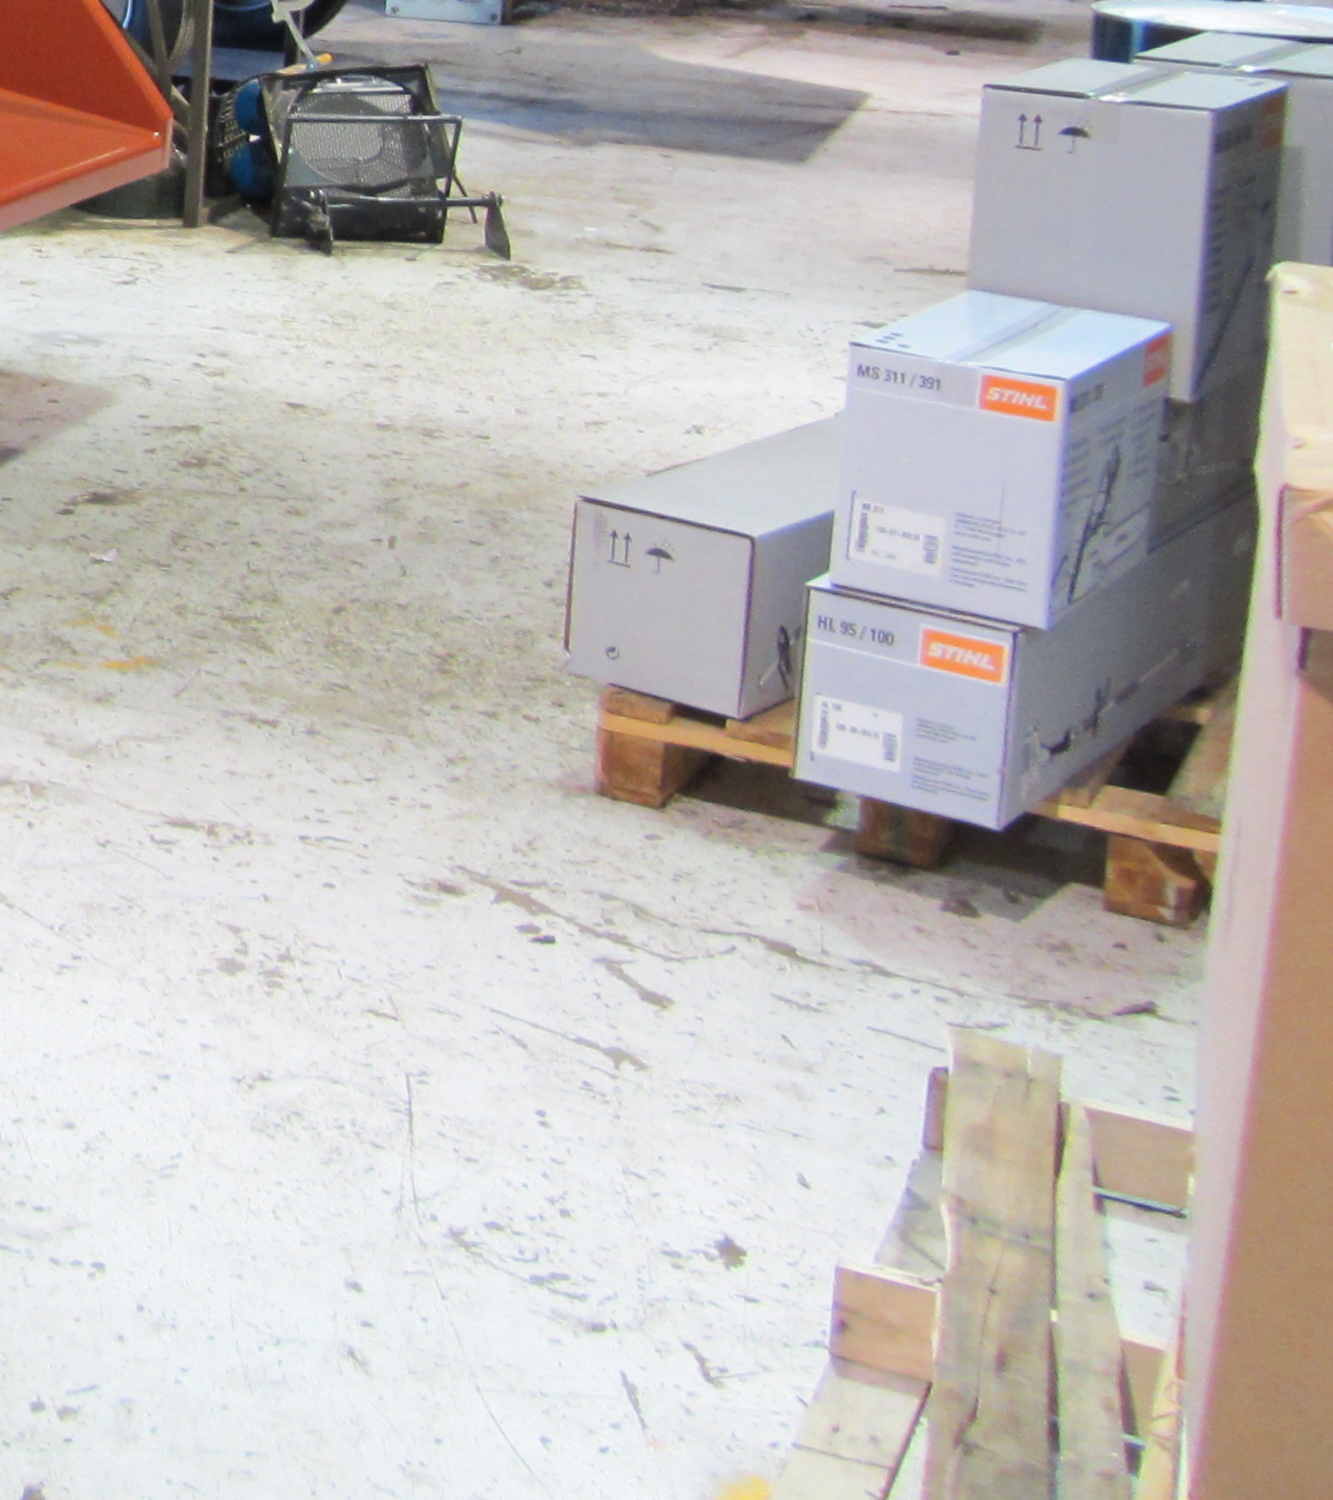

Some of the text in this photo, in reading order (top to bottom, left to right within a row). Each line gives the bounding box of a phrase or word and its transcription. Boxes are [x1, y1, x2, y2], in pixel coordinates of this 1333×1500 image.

[857, 364, 880, 380] MS
[884, 369, 906, 385] 311
[919, 375, 941, 391] 391
[986, 386, 1049, 410] STIHL
[817, 615, 835, 634] HL
[839, 621, 857, 637] 95
[870, 627, 895, 646] 100
[928, 641, 997, 672] STIHL
